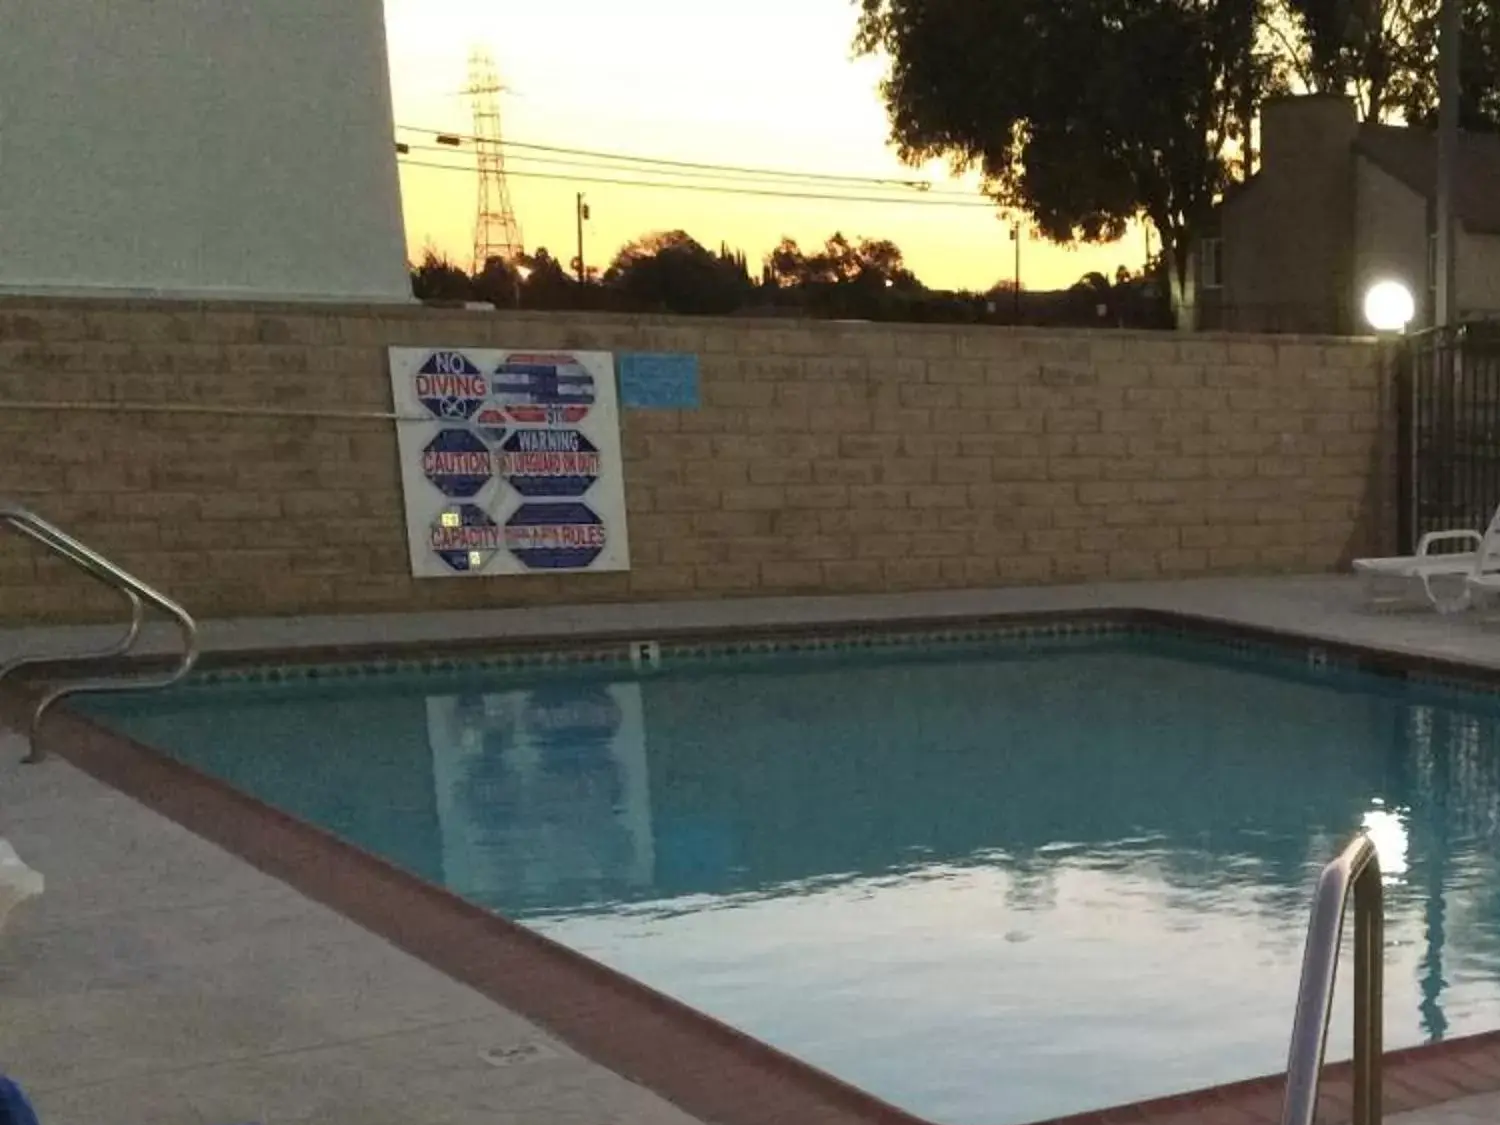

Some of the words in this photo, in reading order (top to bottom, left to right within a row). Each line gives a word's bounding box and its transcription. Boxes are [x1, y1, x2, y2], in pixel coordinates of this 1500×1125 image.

[436, 353, 465, 373] NO
[416, 375, 487, 397] DIVING
[519, 431, 579, 451] WARNING
[424, 452, 490, 474] CAUTION
[432, 526, 498, 547] CAPACITY
